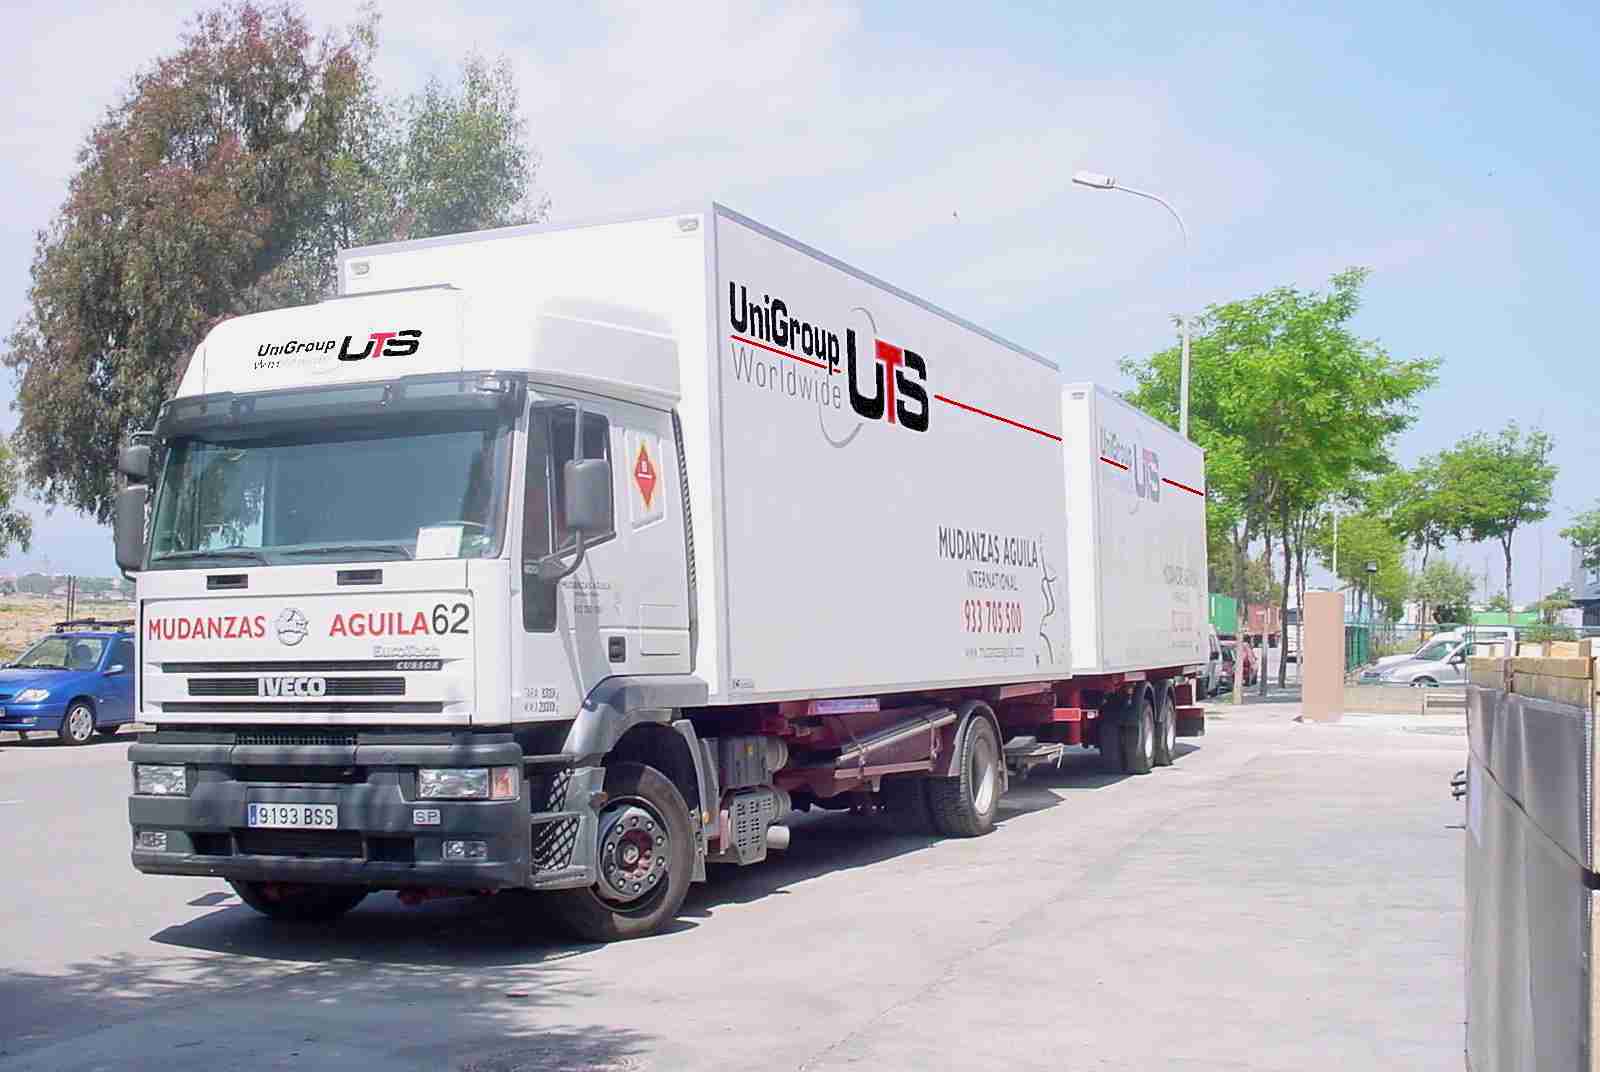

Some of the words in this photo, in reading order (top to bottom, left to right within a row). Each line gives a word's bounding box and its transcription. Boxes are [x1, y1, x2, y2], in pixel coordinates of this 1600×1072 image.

[729, 281, 840, 375] UniGroup
[257, 340, 336, 358] UniGroup
[337, 329, 423, 361] UTS
[731, 342, 842, 410] Worldwide
[846, 328, 930, 433] UTS
[938, 525, 1000, 565] MUDANZAS
[1003, 536, 1039, 568] AGUILA
[149, 615, 266, 641] MUDANZAS
[329, 611, 430, 637] AGUILA
[431, 603, 469, 635] 62
[964, 600, 983, 633] 933
[986, 601, 1003, 633] 705
[1006, 602, 1022, 633] 500
[258, 677, 326, 697] IVECO
[259, 808, 298, 824] 9193
[304, 808, 334, 825] BSS
[415, 811, 438, 823] SP
